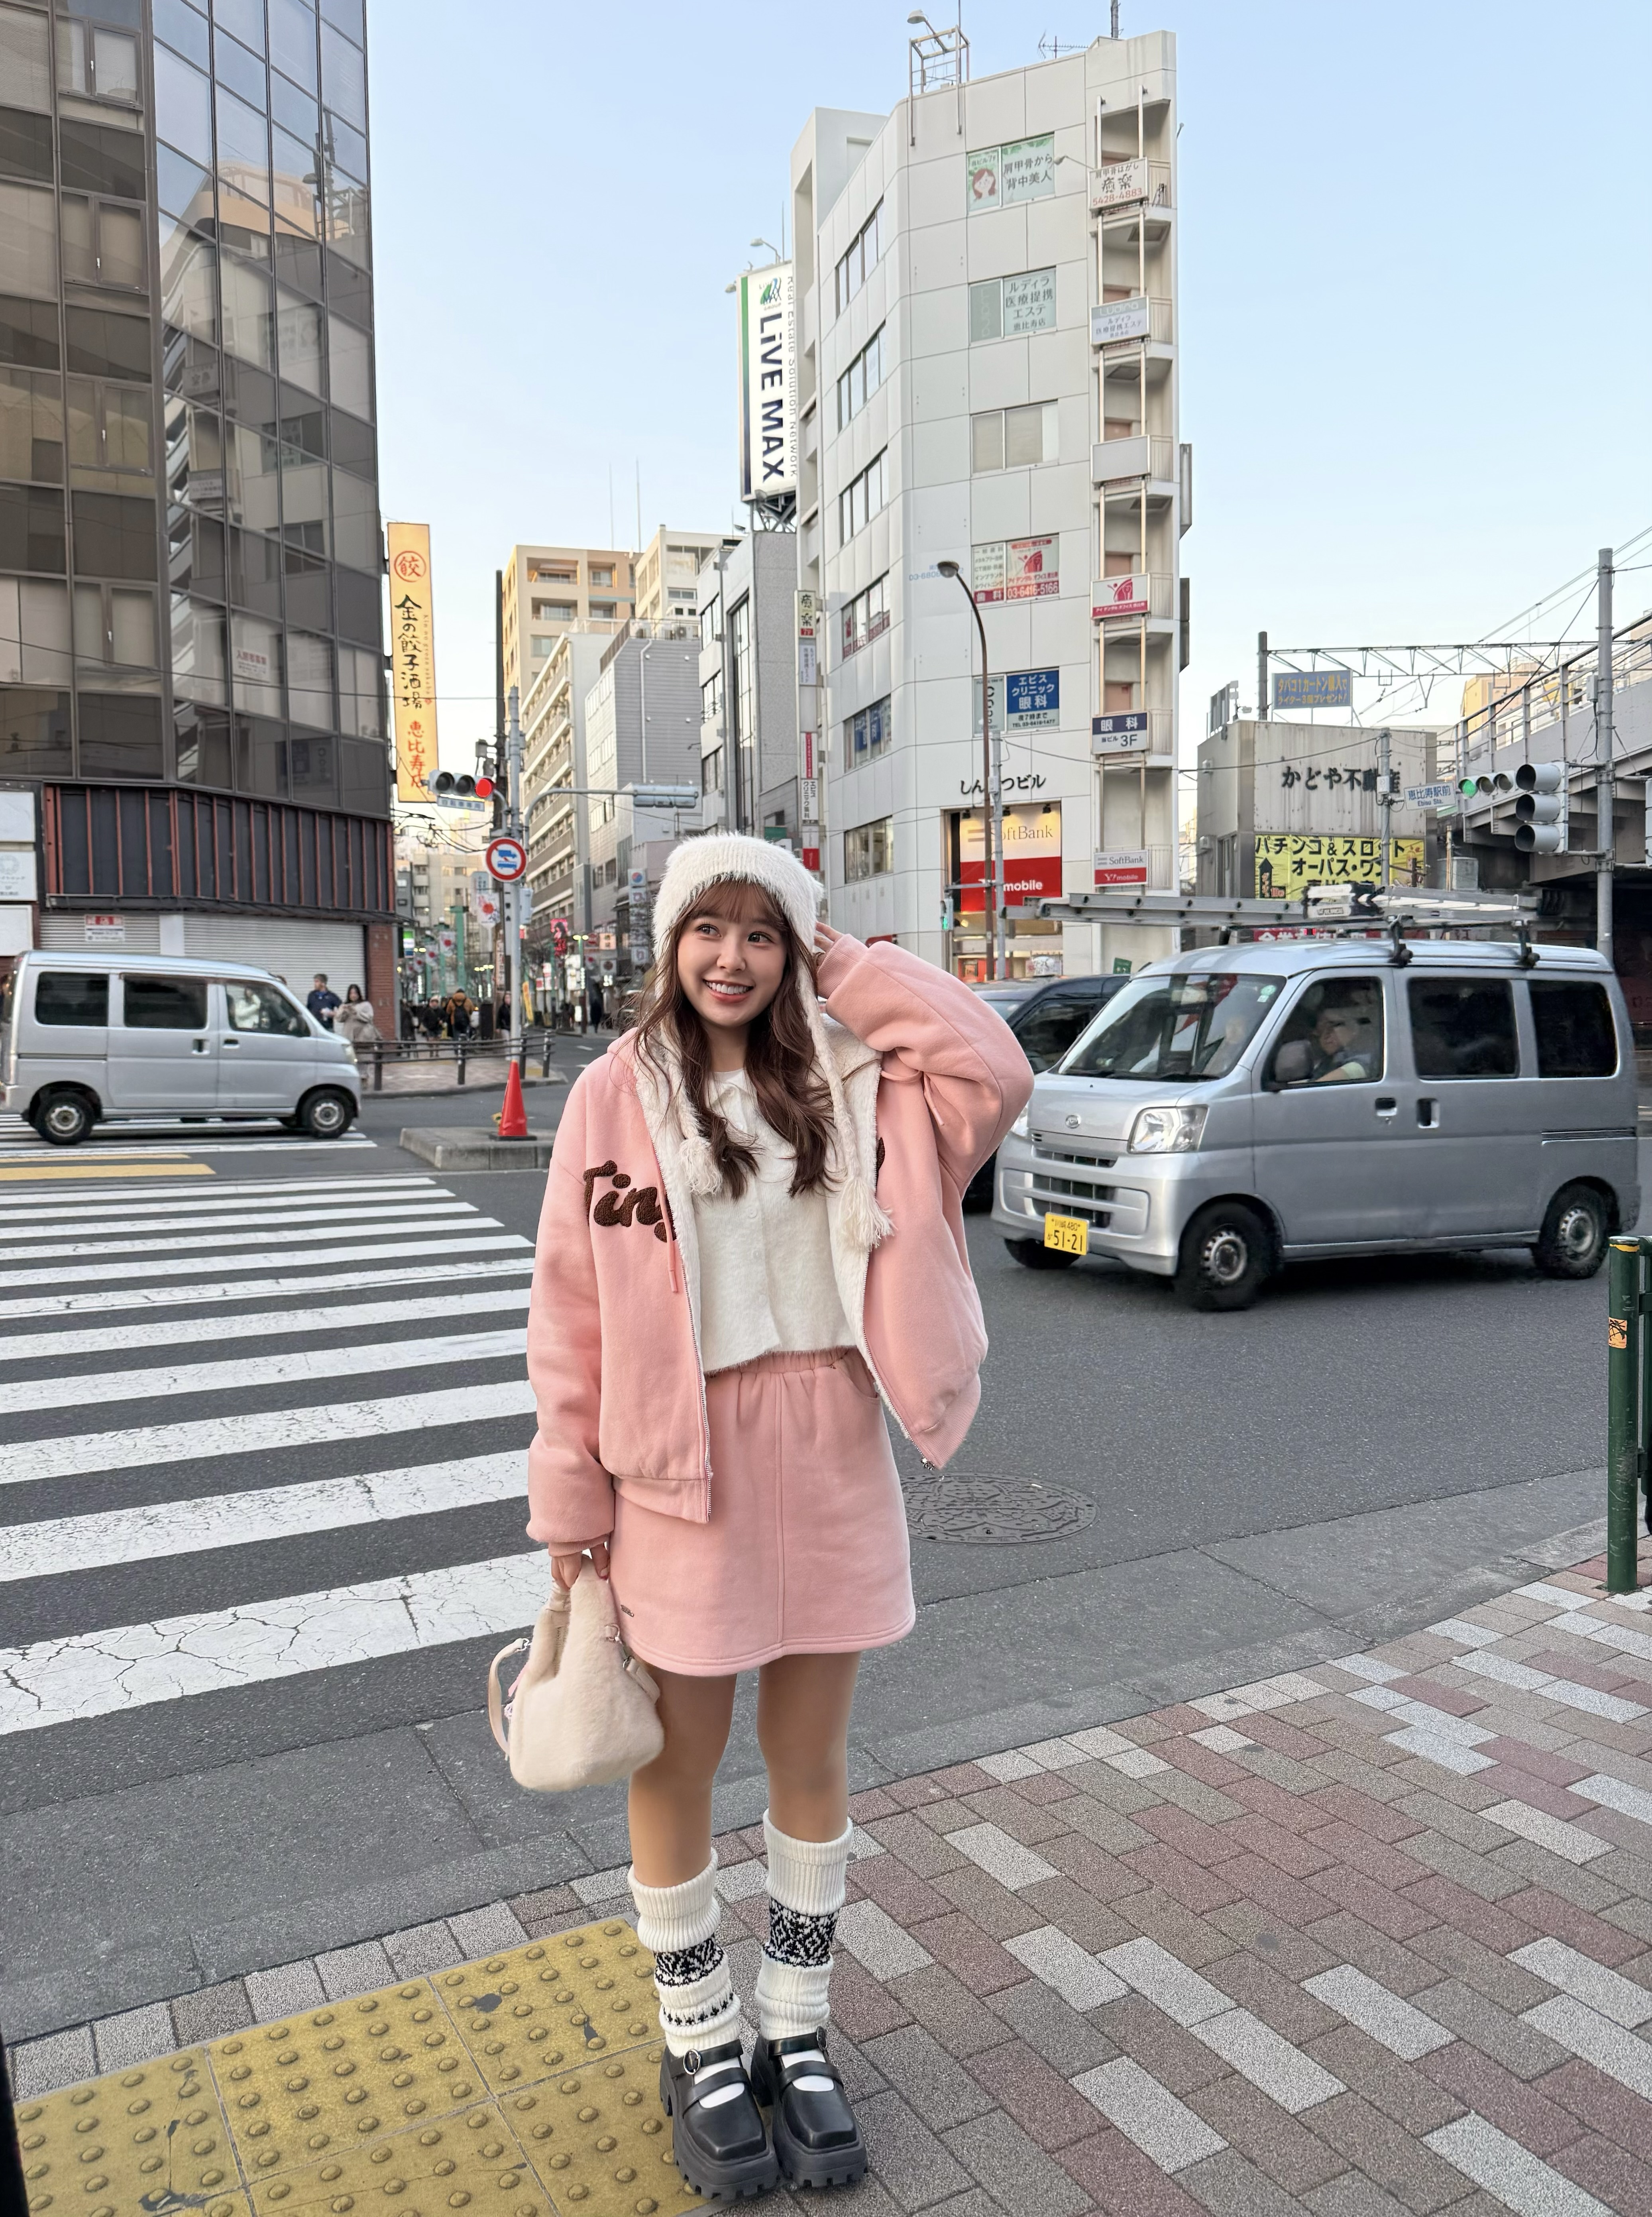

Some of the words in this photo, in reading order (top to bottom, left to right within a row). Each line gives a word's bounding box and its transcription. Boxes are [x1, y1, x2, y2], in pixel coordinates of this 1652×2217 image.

[1004, 153, 1053, 175] 肩甲骨から
[1095, 162, 1139, 179] 肩甲骨はがし
[1007, 170, 1052, 191] 背中美人
[1092, 187, 1142, 206] 5428-4883
[1009, 276, 1050, 294] ルディラ
[1006, 288, 1053, 308] 医療提携
[1013, 304, 1046, 319] エステ
[762, 398, 784, 483] MAX
[976, 590, 1002, 602] 歯科
[1007, 582, 1059, 598] 03-6416-5166
[394, 594, 422, 710] 金の餃子酒場
[1018, 674, 1047, 686] エビス
[1011, 683, 1055, 697] クリニック
[1019, 694, 1047, 710] 眼科
[1100, 715, 1138, 732] 眼科
[1120, 734, 1137, 747] 3F
[960, 774, 1046, 795] しんつビル
[1408, 785, 1451, 800] 恵比寿駅前
[1255, 835, 1405, 858] パチンコ&スロト
[1109, 856, 1144, 865] SoftBank
